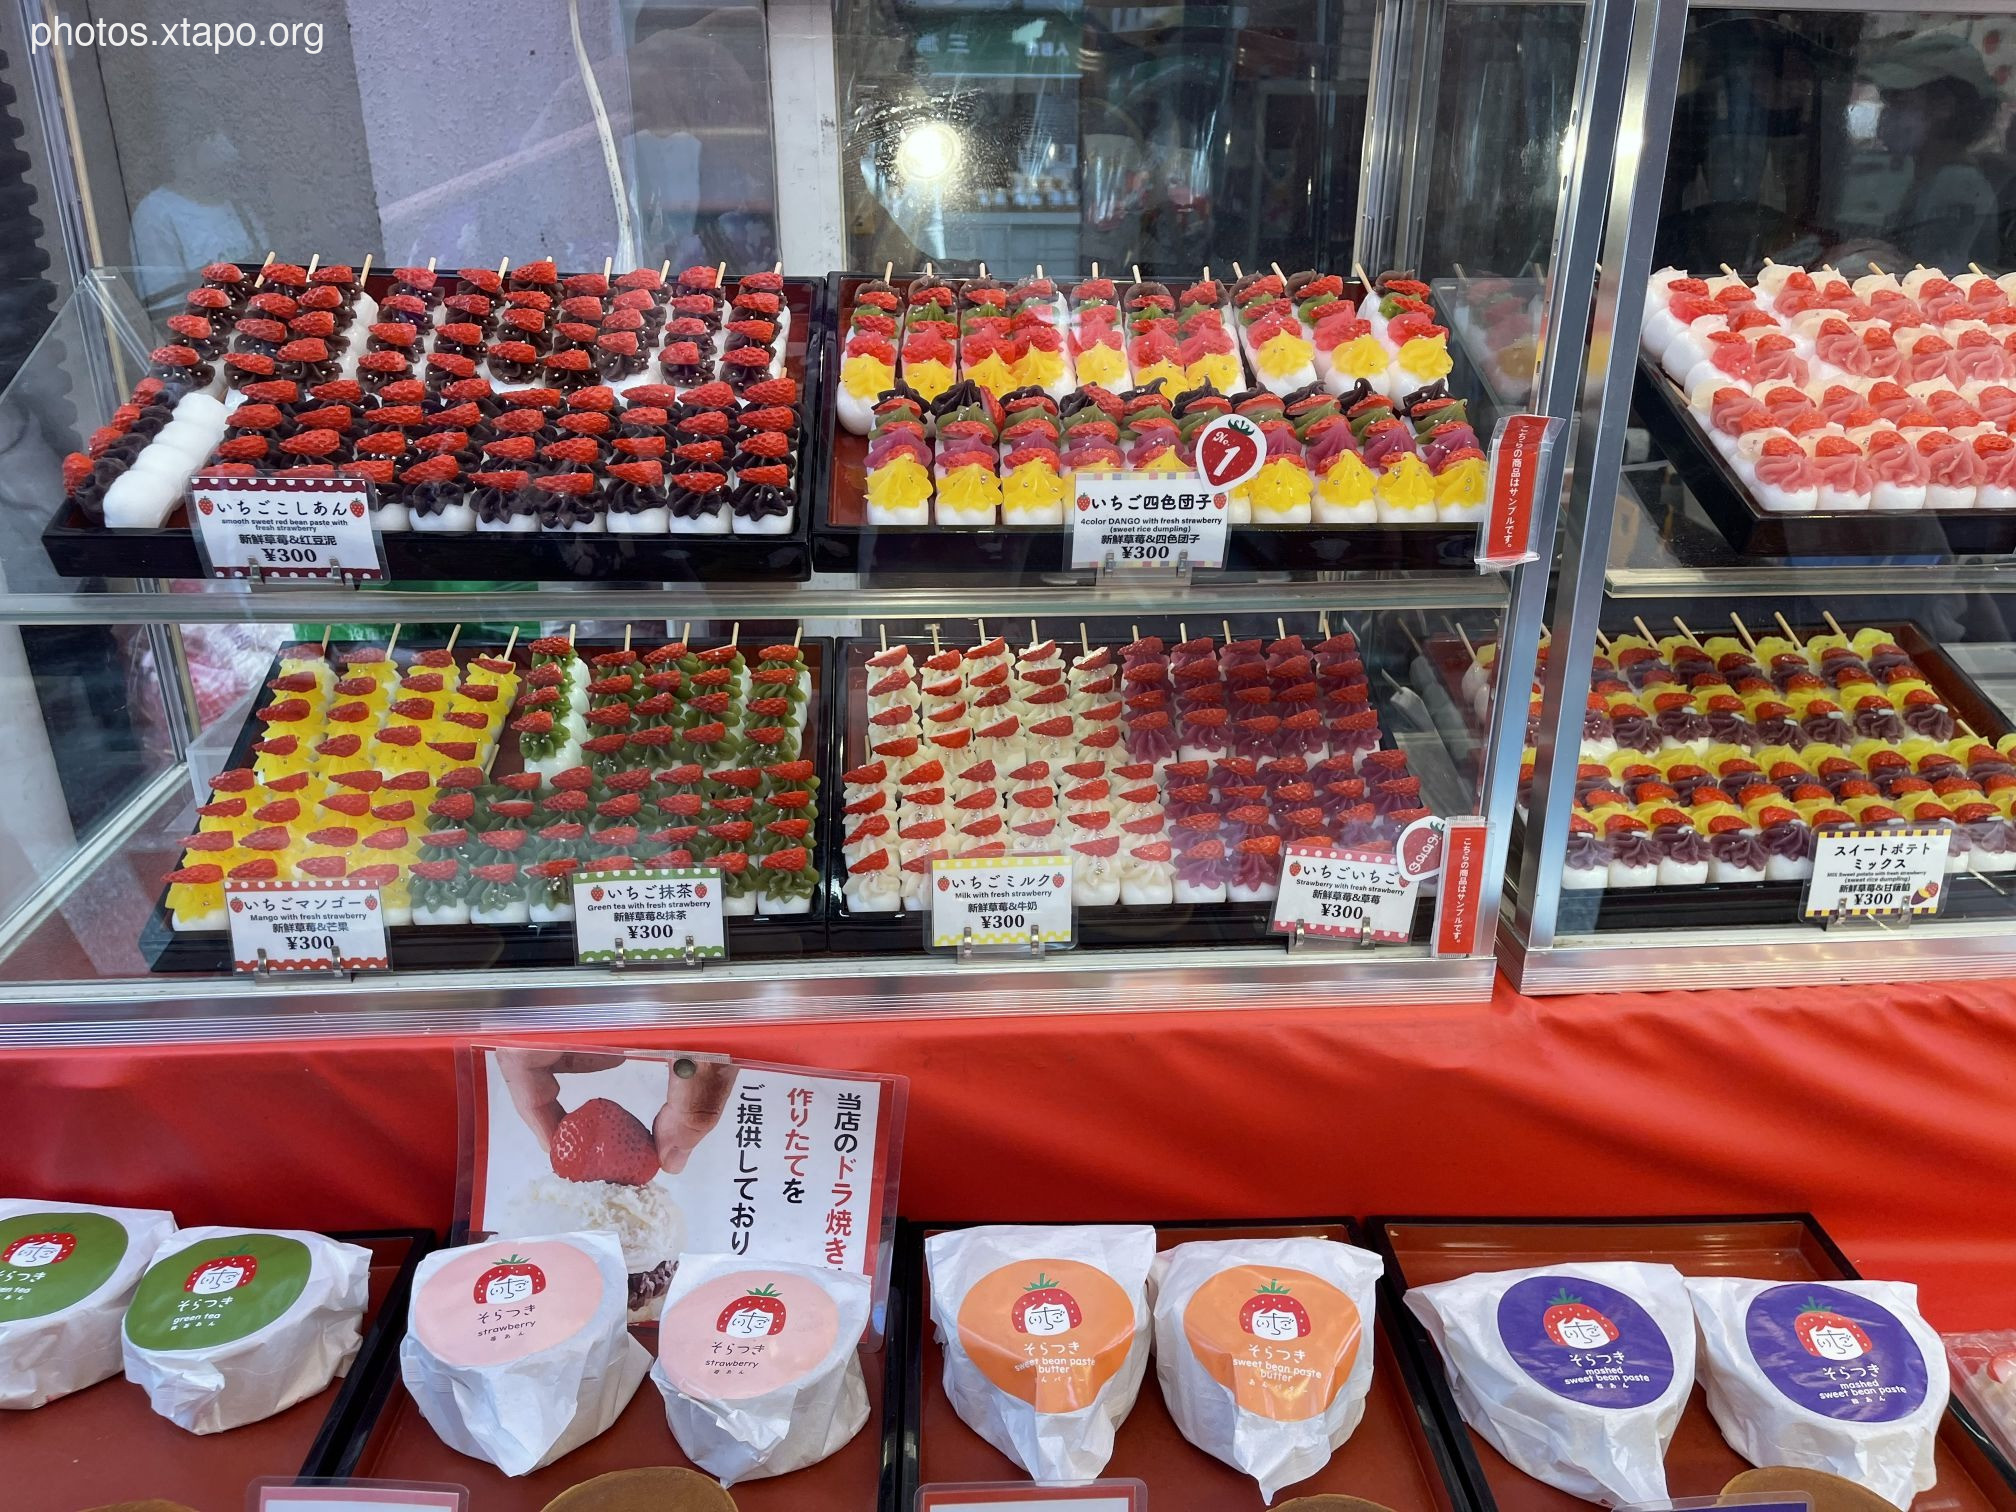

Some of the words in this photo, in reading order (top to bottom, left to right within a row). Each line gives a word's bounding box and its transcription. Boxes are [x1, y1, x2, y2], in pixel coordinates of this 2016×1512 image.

[1212, 431, 1231, 447] No.
[1213, 445, 1241, 477] 1
[1503, 425, 1530, 548] こちらの商品はサンプルです。
[217, 500, 347, 516] いちごこしあん
[1092, 494, 1211, 510] いちご四色団子
[276, 525, 317, 533] strawberry
[309, 519, 330, 527] paste
[1142, 517, 1159, 525] with
[1160, 517, 1180, 525] fresh
[1181, 517, 1222, 526] strawberry
[261, 548, 317, 562] ¥300
[1121, 545, 1170, 559] ¥300
[1834, 842, 1930, 856] スイートポテト
[1854, 858, 1906, 870] ミックス
[952, 874, 1050, 890] いちごミルク
[1303, 864, 1400, 885] いちごいちご
[607, 883, 692, 900] いちご抹茶
[1011, 890, 1053, 898] strawberry
[1296, 879, 1333, 889] Strawberry
[1350, 883, 1367, 891] fresh
[1368, 885, 1405, 896] strawberry
[1452, 837, 1472, 943] こちらの商品はサンプルです。
[244, 896, 361, 912] いちごマンゴー
[587, 903, 612, 911] Green
[646, 901, 667, 909] fresh
[1854, 893, 1893, 906] ¥300
[250, 914, 279, 922] Mango
[1321, 903, 1363, 919] ¥300
[980, 914, 1025, 928] ¥300
[626, 924, 673, 939] ¥300
[286, 935, 334, 950] ¥300
[782, 1087, 814, 1204] 作りたてを
[730, 1084, 766, 1255] ご提供しており
[825, 1092, 861, 1270] 当店のドラ焼き
[177, 1295, 234, 1312] そらつき
[172, 1314, 202, 1325] green
[477, 1304, 536, 1324] そらつき
[477, 1320, 536, 1337] strawberry
[711, 1341, 765, 1356] そらつき
[1024, 1341, 1080, 1356] そらつき
[1248, 1343, 1306, 1364] そらつき
[705, 1359, 760, 1369] strawberry
[1014, 1357, 1038, 1372] sweet
[1042, 1357, 1067, 1365] bean
[1070, 1357, 1096, 1366] paste
[1569, 1350, 1625, 1367] そらつき
[1038, 1365, 1070, 1374] butter
[1233, 1358, 1262, 1368] sweet
[1265, 1361, 1291, 1373] bean
[1293, 1367, 1322, 1379] paste
[1260, 1369, 1293, 1382] butter
[1585, 1366, 1624, 1376] mashed
[1822, 1363, 1880, 1381] そらつき
[1564, 1375, 1594, 1385] sweet
[1595, 1374, 1621, 1382] bean
[1622, 1373, 1650, 1382] paste
[1839, 1379, 1879, 1390] mashed
[1819, 1389, 1849, 1400] sweet
[1850, 1387, 1877, 1396] bean
[1878, 1385, 1907, 1395] paste
